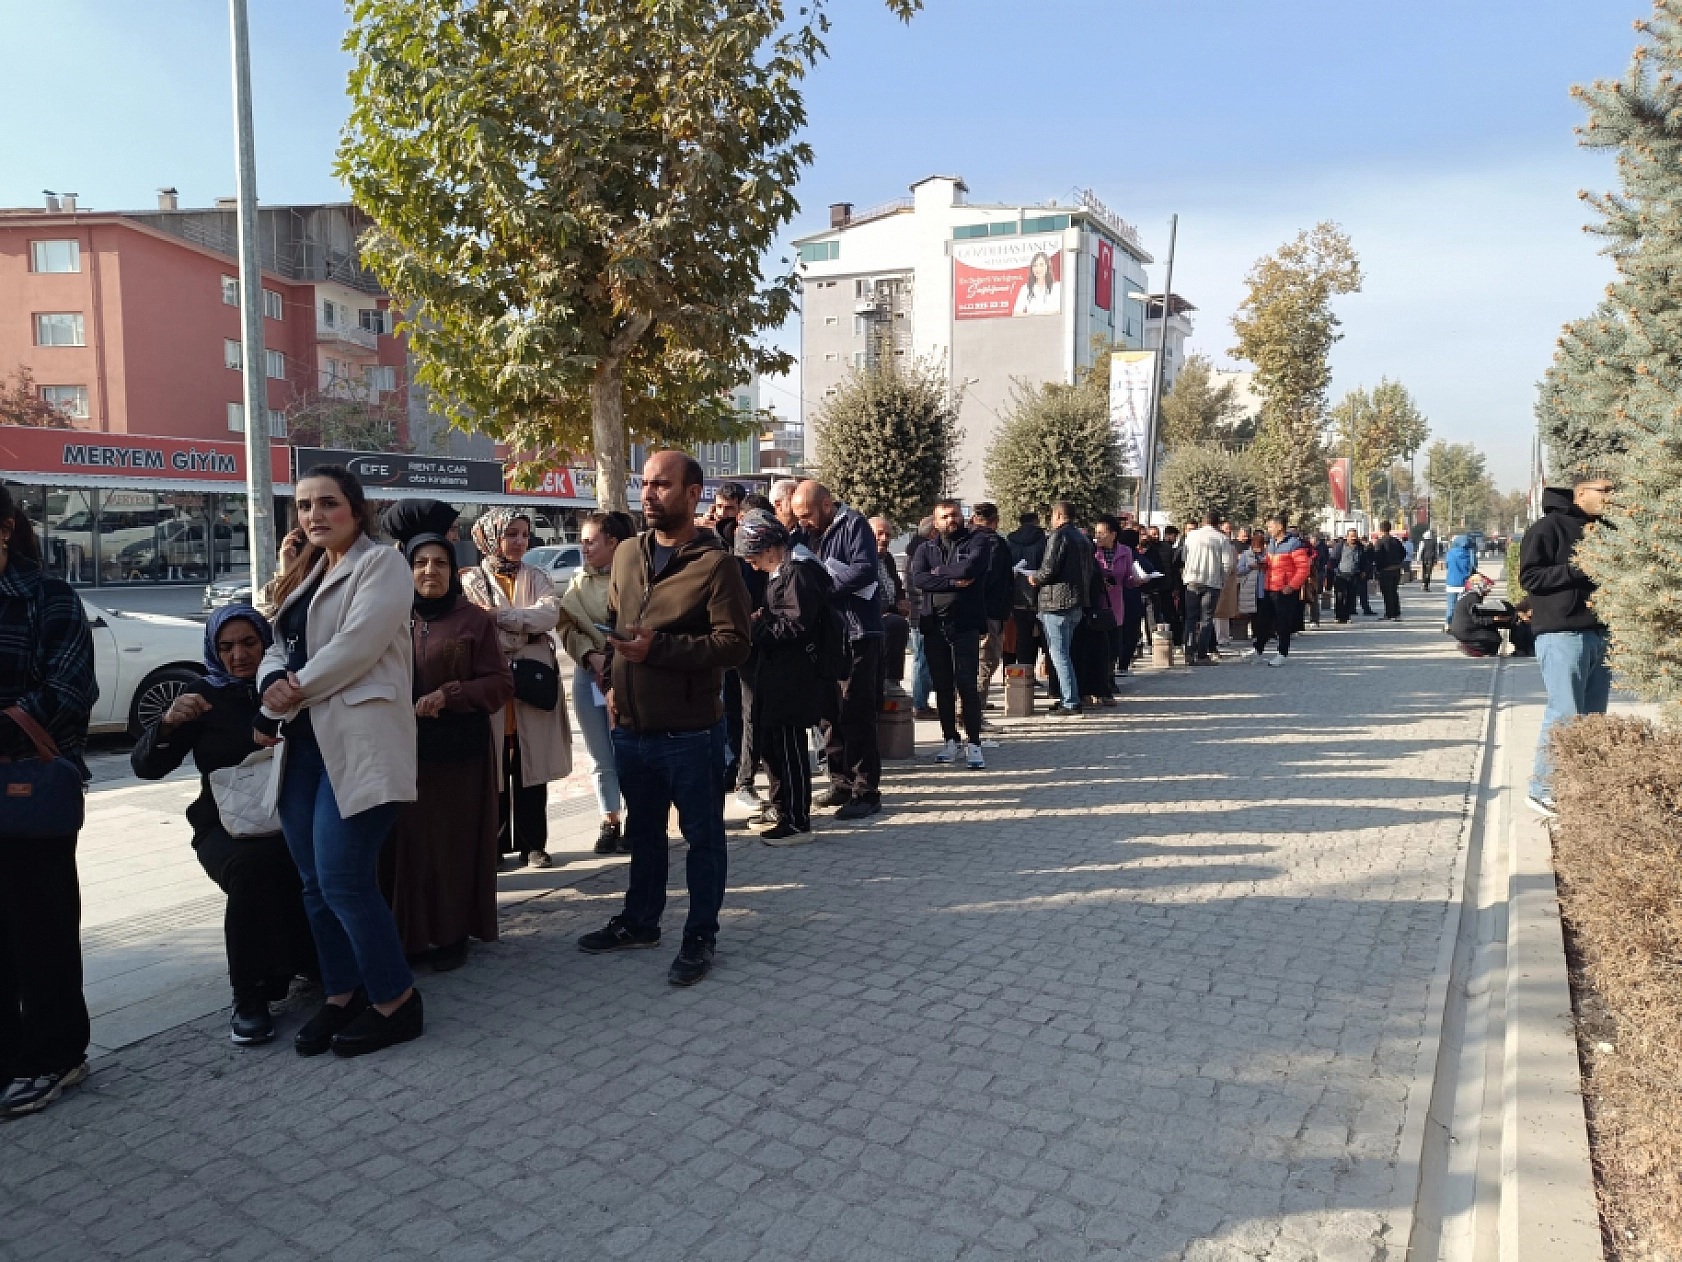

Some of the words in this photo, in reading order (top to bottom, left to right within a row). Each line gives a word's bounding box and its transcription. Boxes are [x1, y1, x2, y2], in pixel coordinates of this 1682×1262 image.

[62, 444, 166, 469] MERYEM
[171, 447, 237, 473] GİYİM
[360, 463, 390, 476] EFE
[408, 461, 437, 472] RENT
[438, 464, 446, 473] A
[447, 464, 468, 474] CAR
